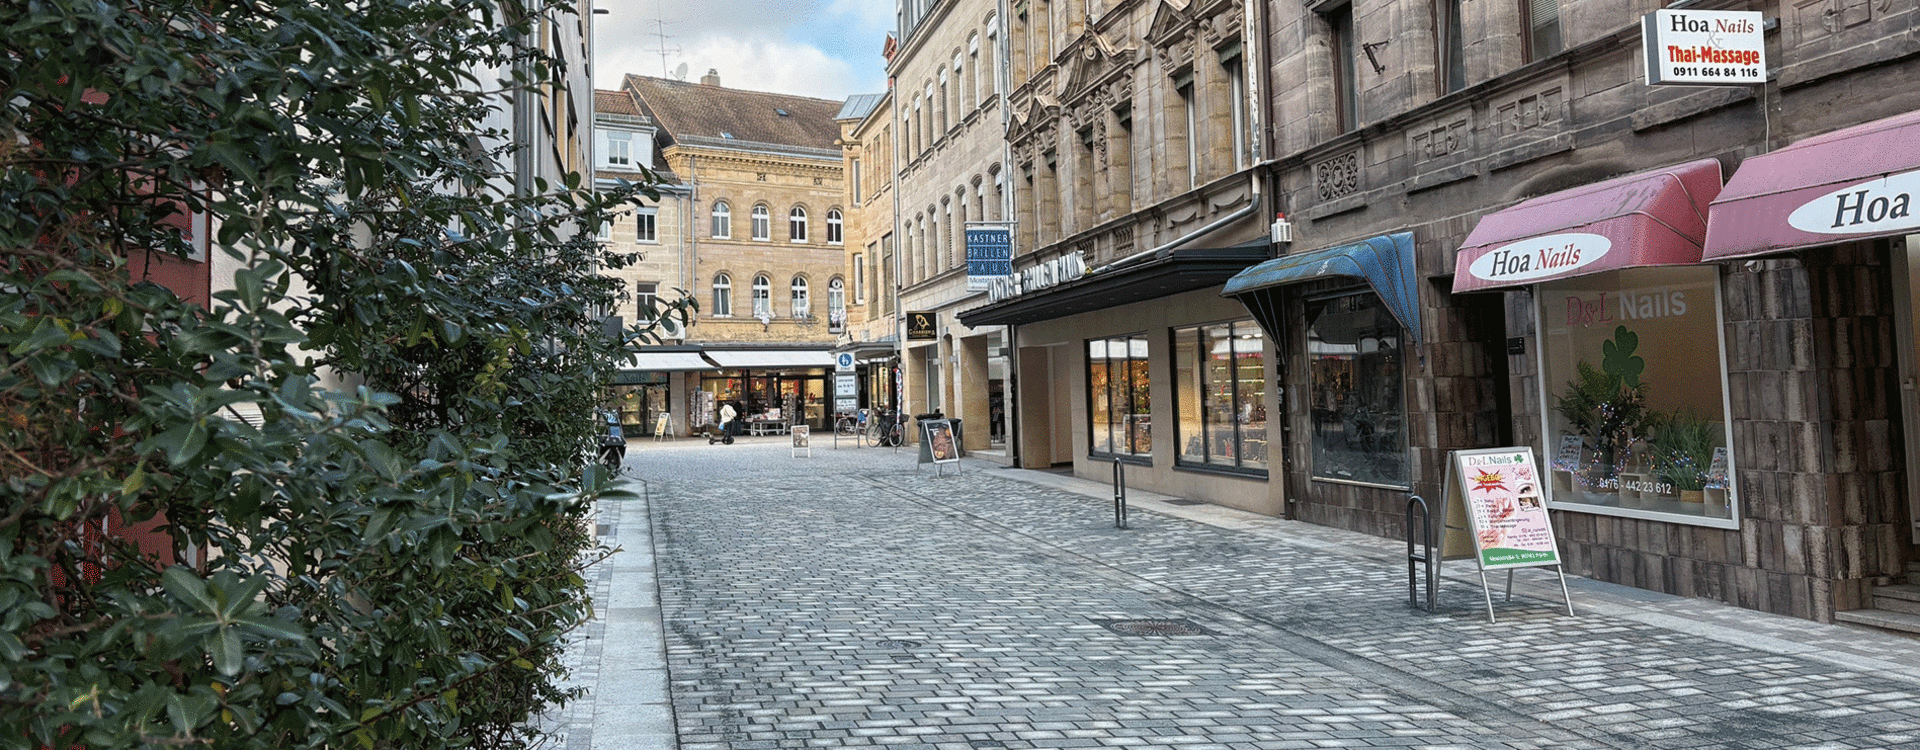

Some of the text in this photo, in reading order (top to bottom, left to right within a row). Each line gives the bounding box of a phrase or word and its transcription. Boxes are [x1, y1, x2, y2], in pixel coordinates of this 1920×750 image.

[1670, 15, 1754, 33] Hoa Nails
[1706, 30, 1723, 49] &
[1668, 45, 1760, 65] Thai-Massage
[1673, 67, 1758, 77] 0911 664 84 116
[1831, 190, 1910, 229] Hoa
[967, 234, 1008, 243] KASTNER
[967, 248, 1008, 258] BRILLEN
[1490, 243, 1581, 277] Hoa Nails
[967, 262, 1009, 271] HAUS
[1565, 285, 1687, 326] D&L Nails
[1489, 455, 1512, 465] Nails
[1625, 480, 1641, 492] 442
[1643, 481, 1654, 493] 23
[1655, 482, 1672, 494] 612
